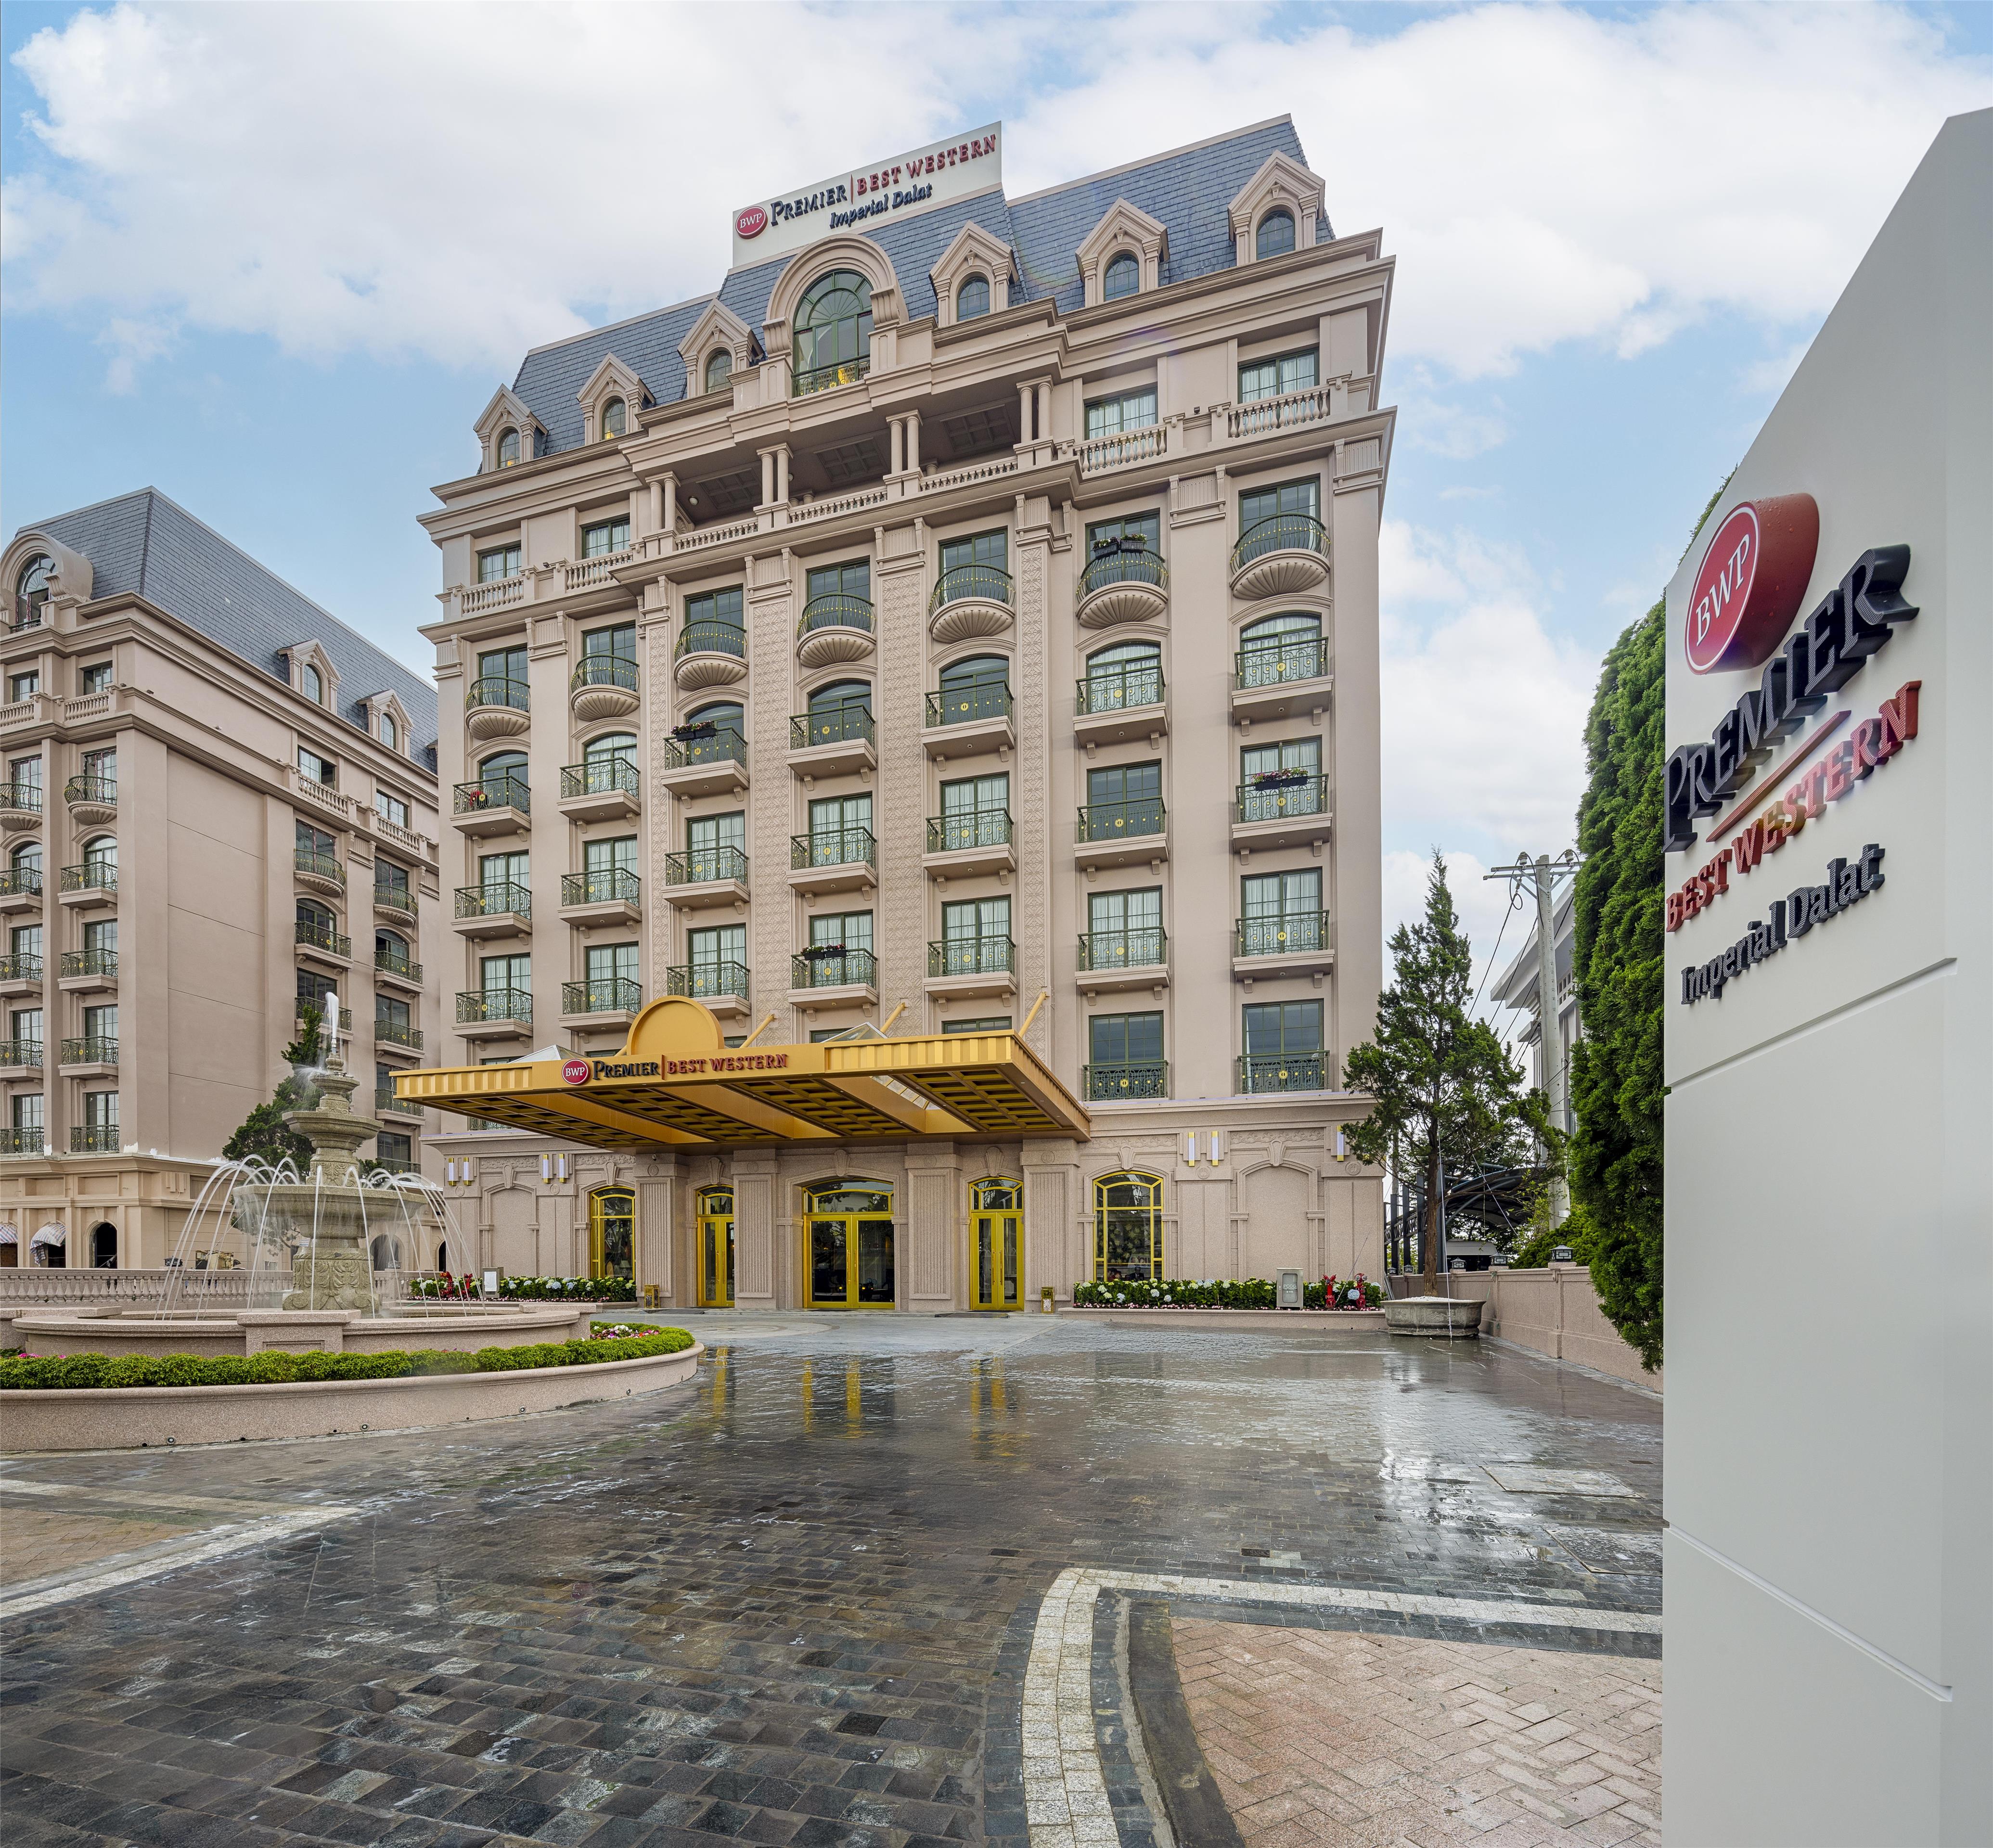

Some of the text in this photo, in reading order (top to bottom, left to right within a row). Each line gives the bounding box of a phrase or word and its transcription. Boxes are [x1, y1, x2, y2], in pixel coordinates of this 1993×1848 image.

[739, 212, 762, 229] BWP
[771, 134, 996, 226] PREMIER BEST WESTERN
[829, 182, 933, 229] Imperial Dalat
[1695, 533, 1751, 647] BWP
[1661, 543, 1920, 853] PREMIER
[1666, 680, 1922, 933] BEST WESTERN
[1681, 843, 1886, 1005] Imperial Dalat
[565, 1053, 788, 1080] BWP PREMIER BEST WESTERN
